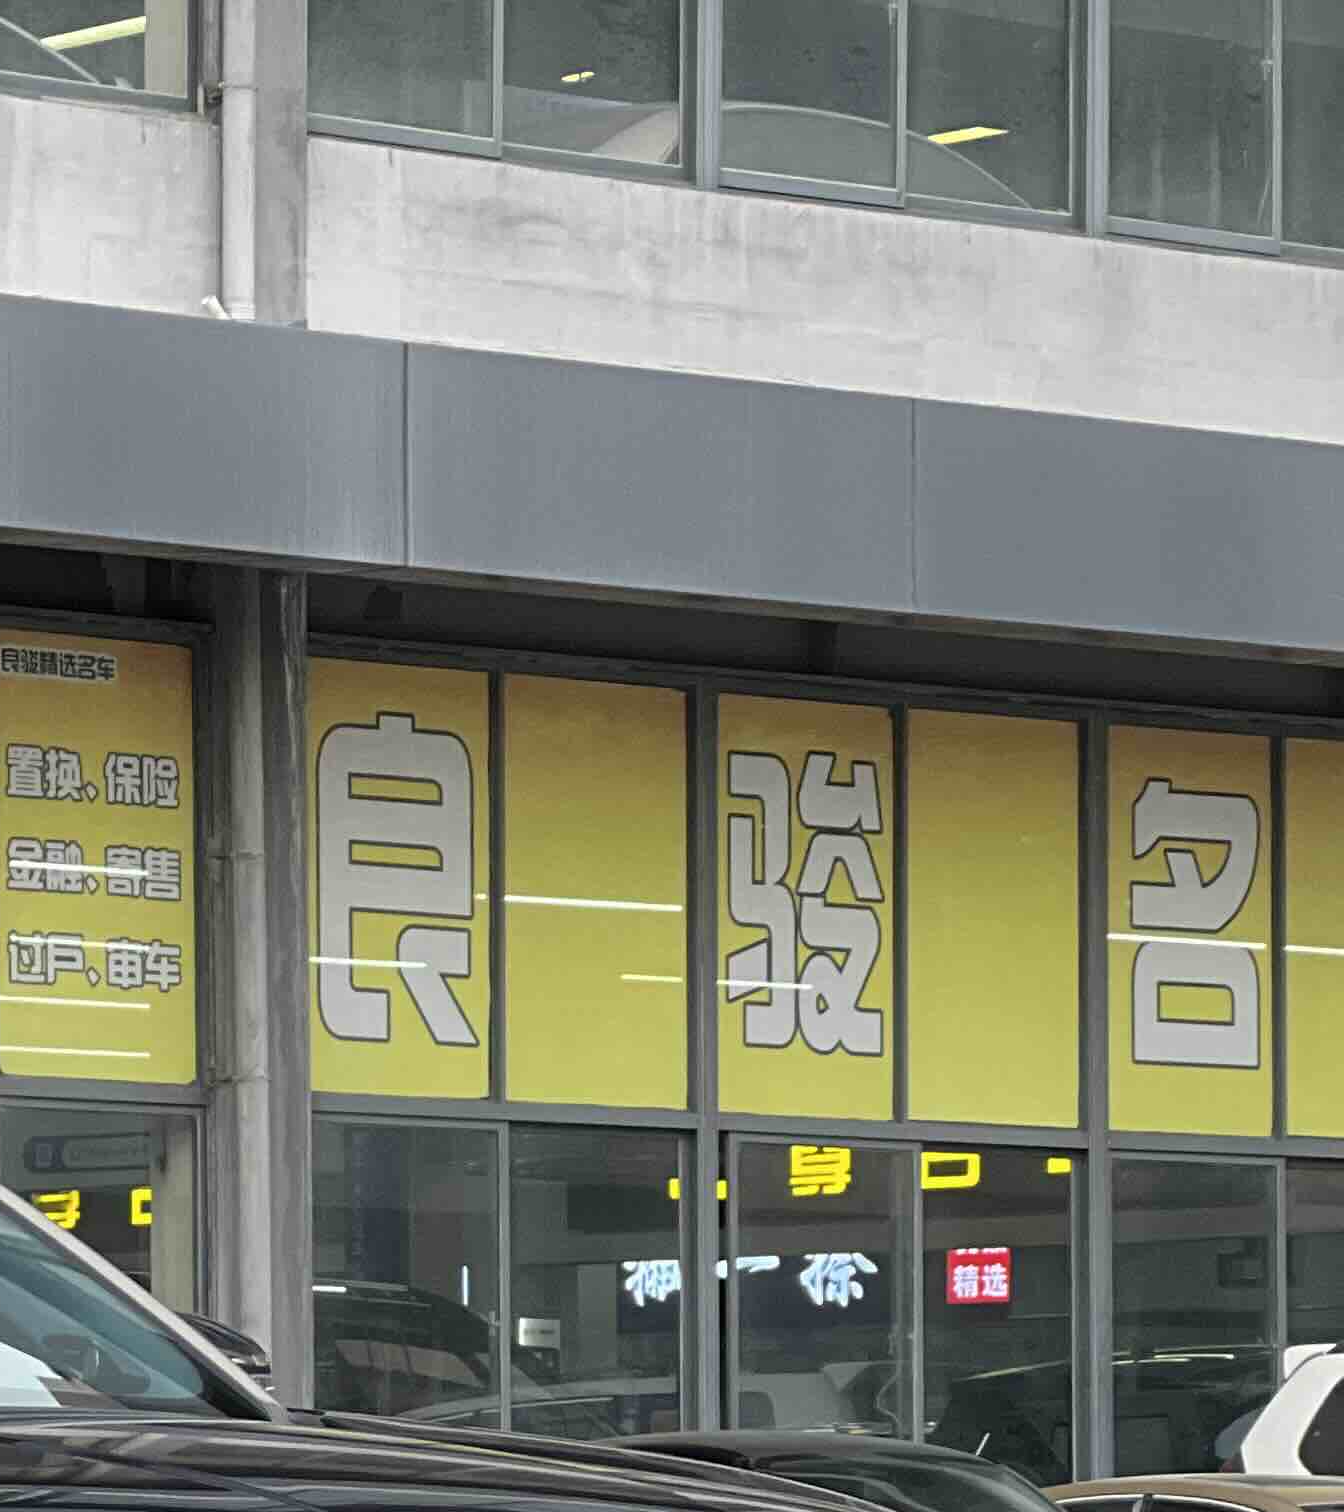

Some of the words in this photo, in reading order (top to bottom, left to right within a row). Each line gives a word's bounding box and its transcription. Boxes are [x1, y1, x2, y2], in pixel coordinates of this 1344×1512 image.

[1, 648, 115, 681] 良骏精选名车
[6, 743, 180, 809] 置换、保险
[6, 836, 182, 902] 金融、寄售
[317, 711, 480, 1047] 良
[725, 750, 885, 1057] 骏
[1129, 776, 1261, 1070] 名
[8, 929, 182, 993] 过户、审车
[952, 1262, 1008, 1299] 精选
